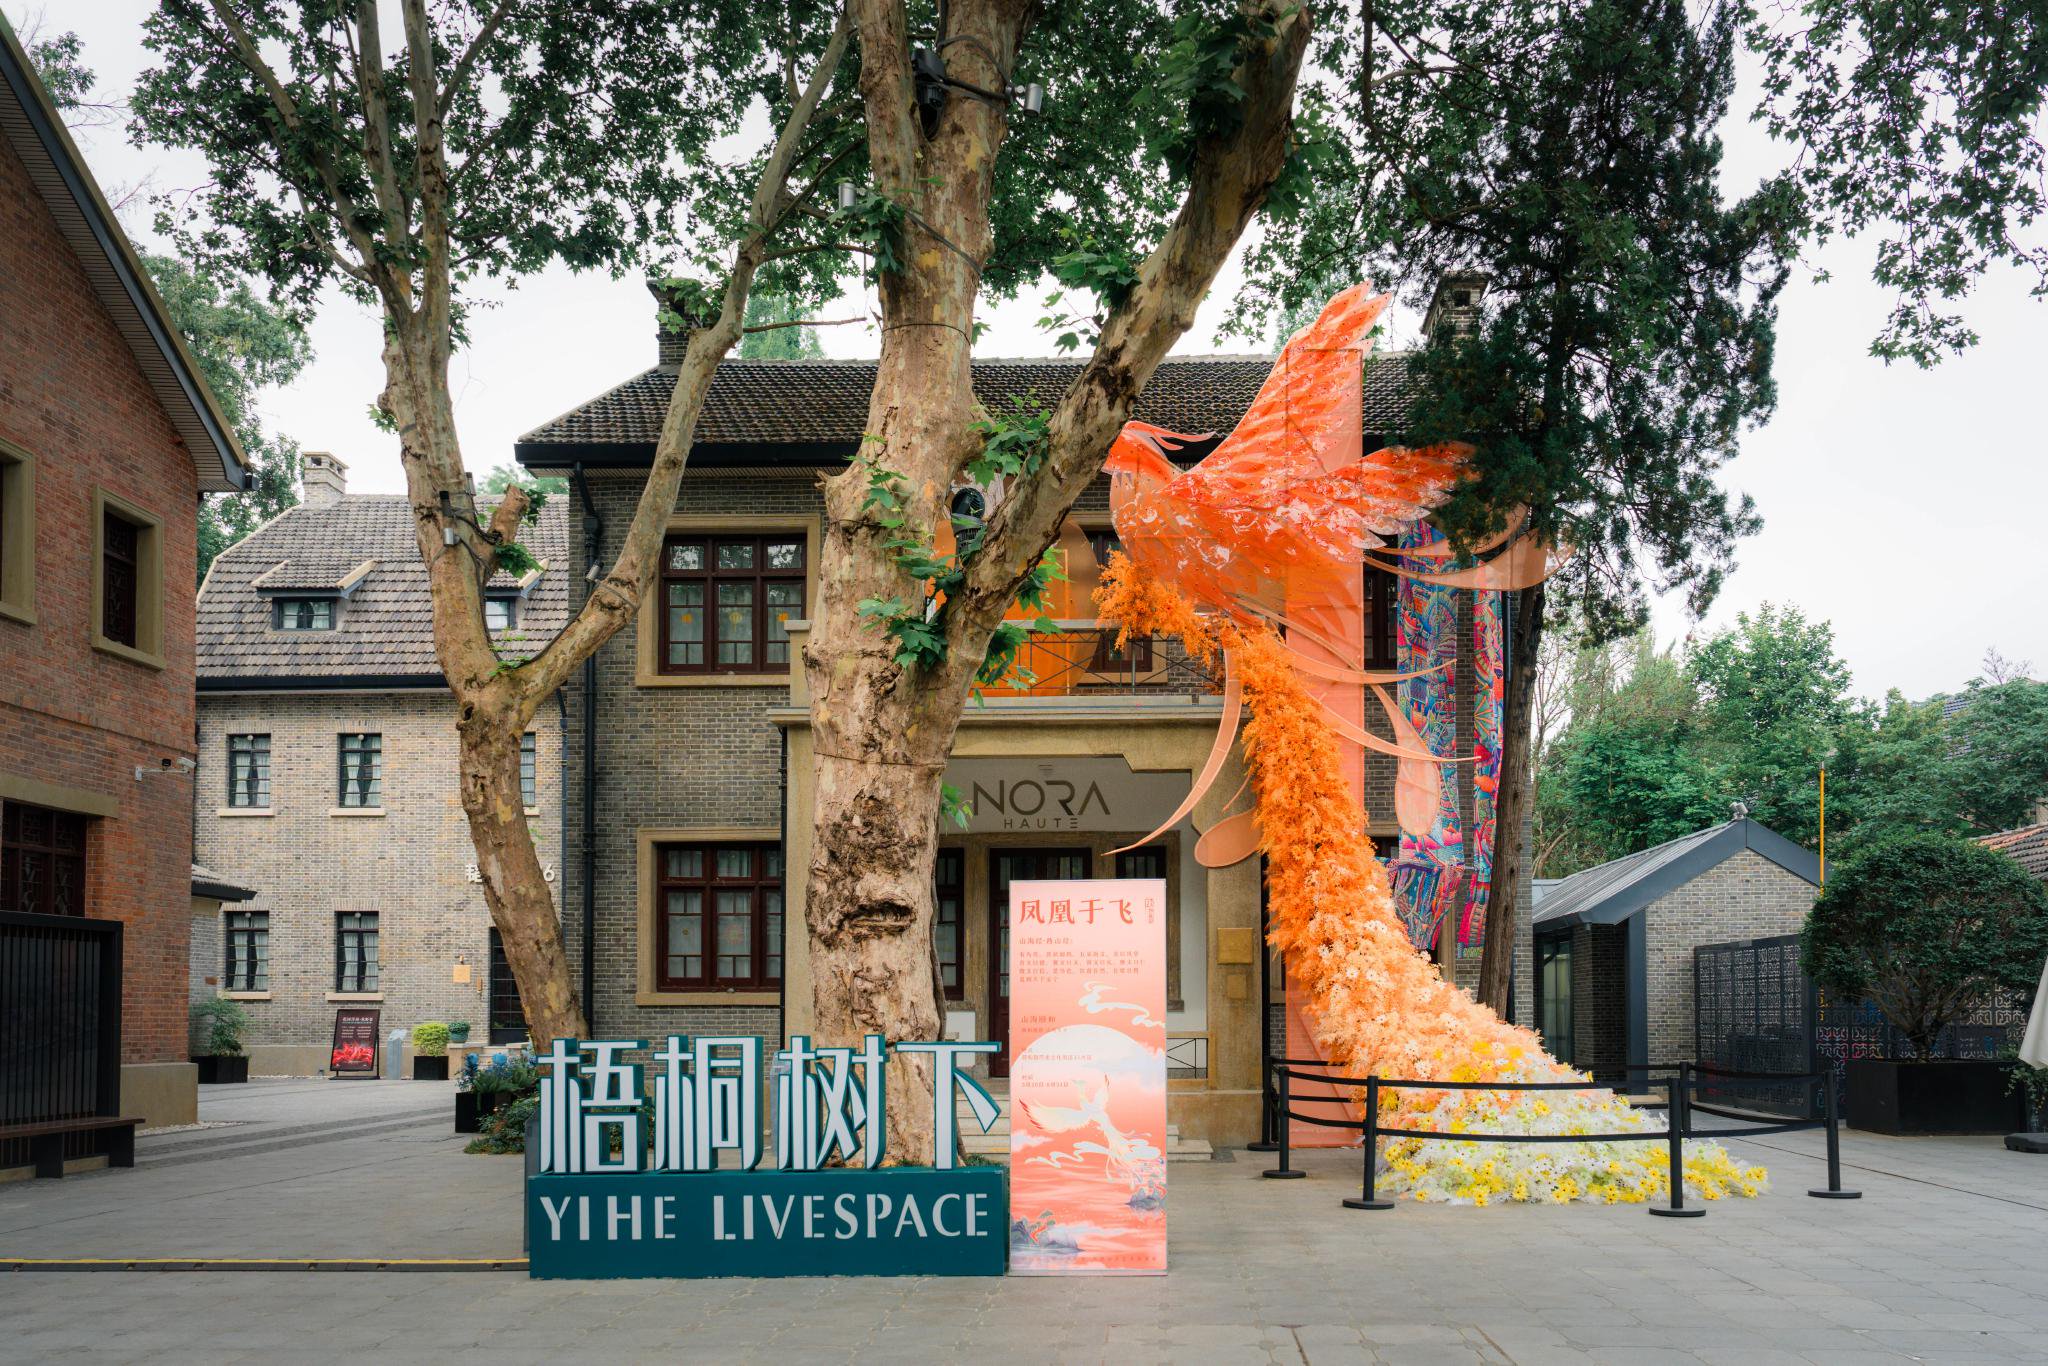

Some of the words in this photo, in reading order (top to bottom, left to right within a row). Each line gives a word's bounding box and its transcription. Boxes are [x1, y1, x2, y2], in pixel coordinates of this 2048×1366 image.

[973, 779, 1111, 816] NORA
[1003, 817, 1079, 829] HAUTE
[1019, 898, 1134, 924] 凤凰于飞
[537, 1035, 1002, 1174] 梧桐树下
[540, 1195, 677, 1241] YIHE
[713, 1192, 989, 1240] LIVESPACE
